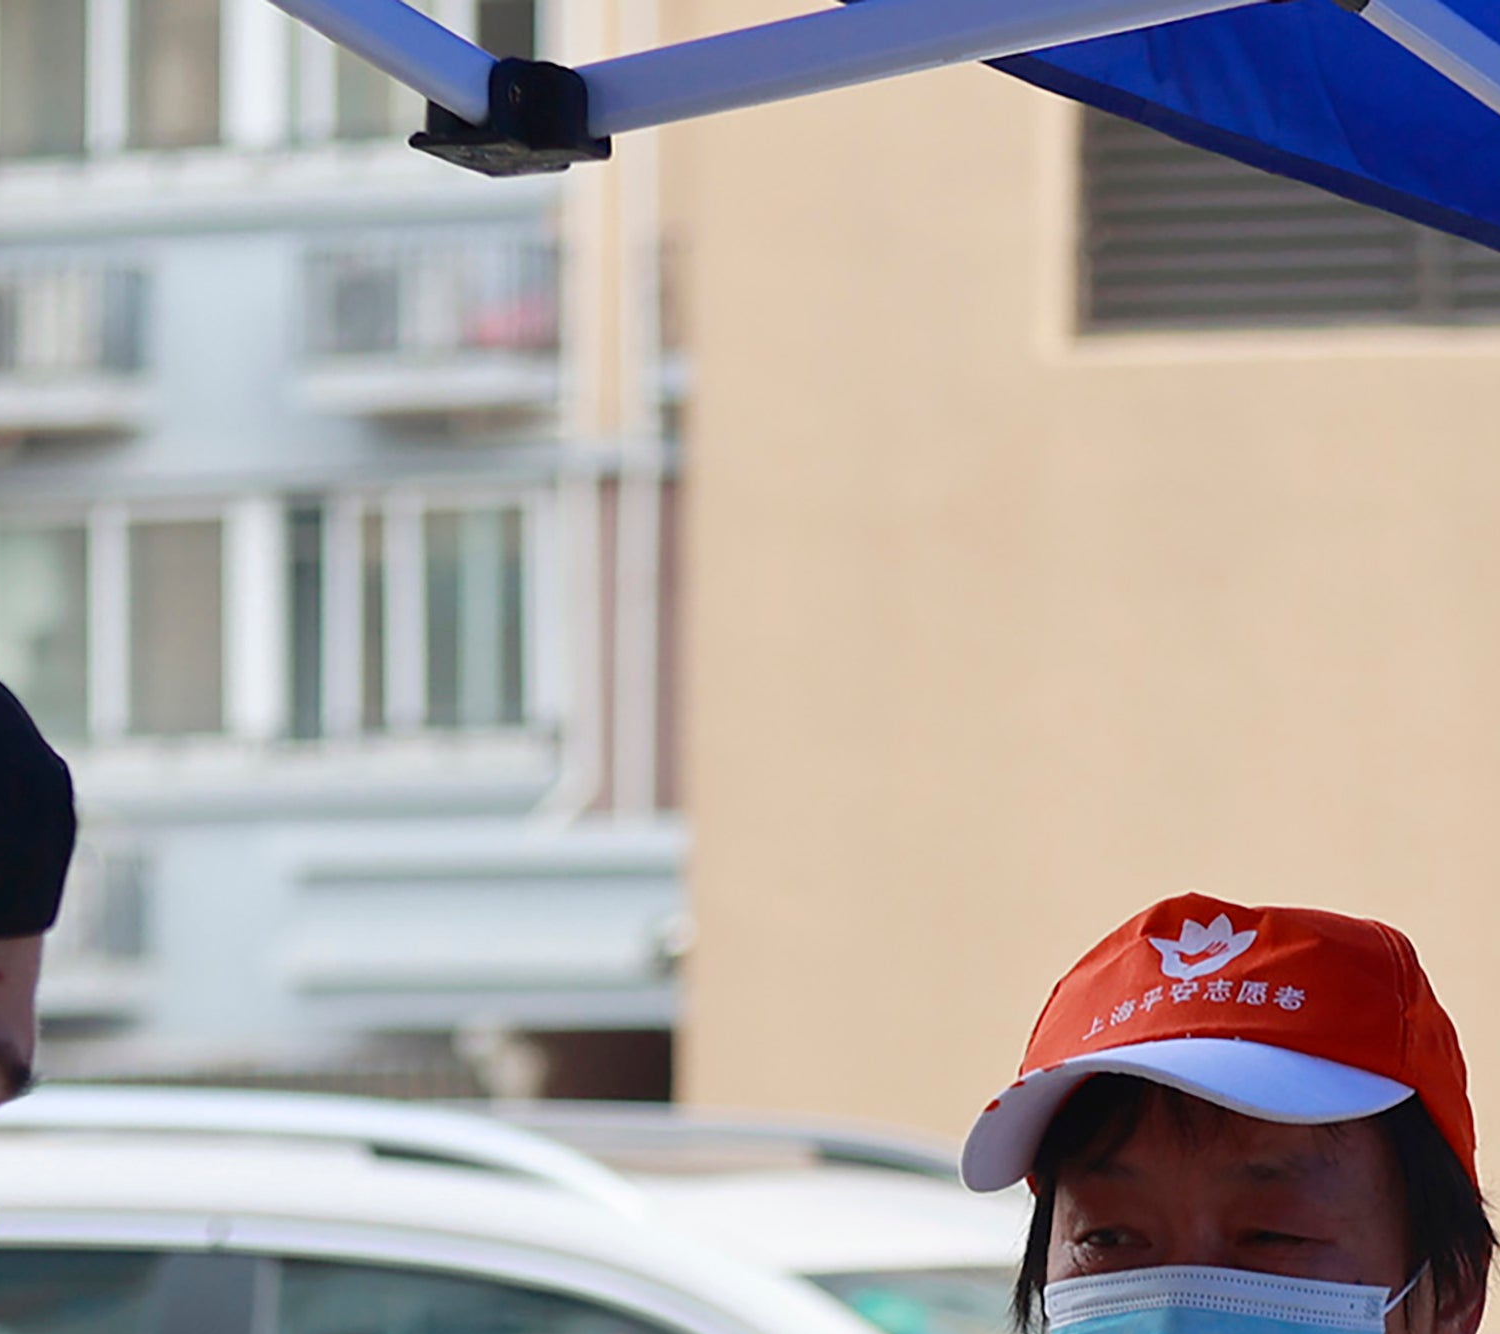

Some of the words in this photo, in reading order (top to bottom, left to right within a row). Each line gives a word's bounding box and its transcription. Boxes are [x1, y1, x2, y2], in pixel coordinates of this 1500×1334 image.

[1081, 977, 1307, 1040] 上海平安志愿者
